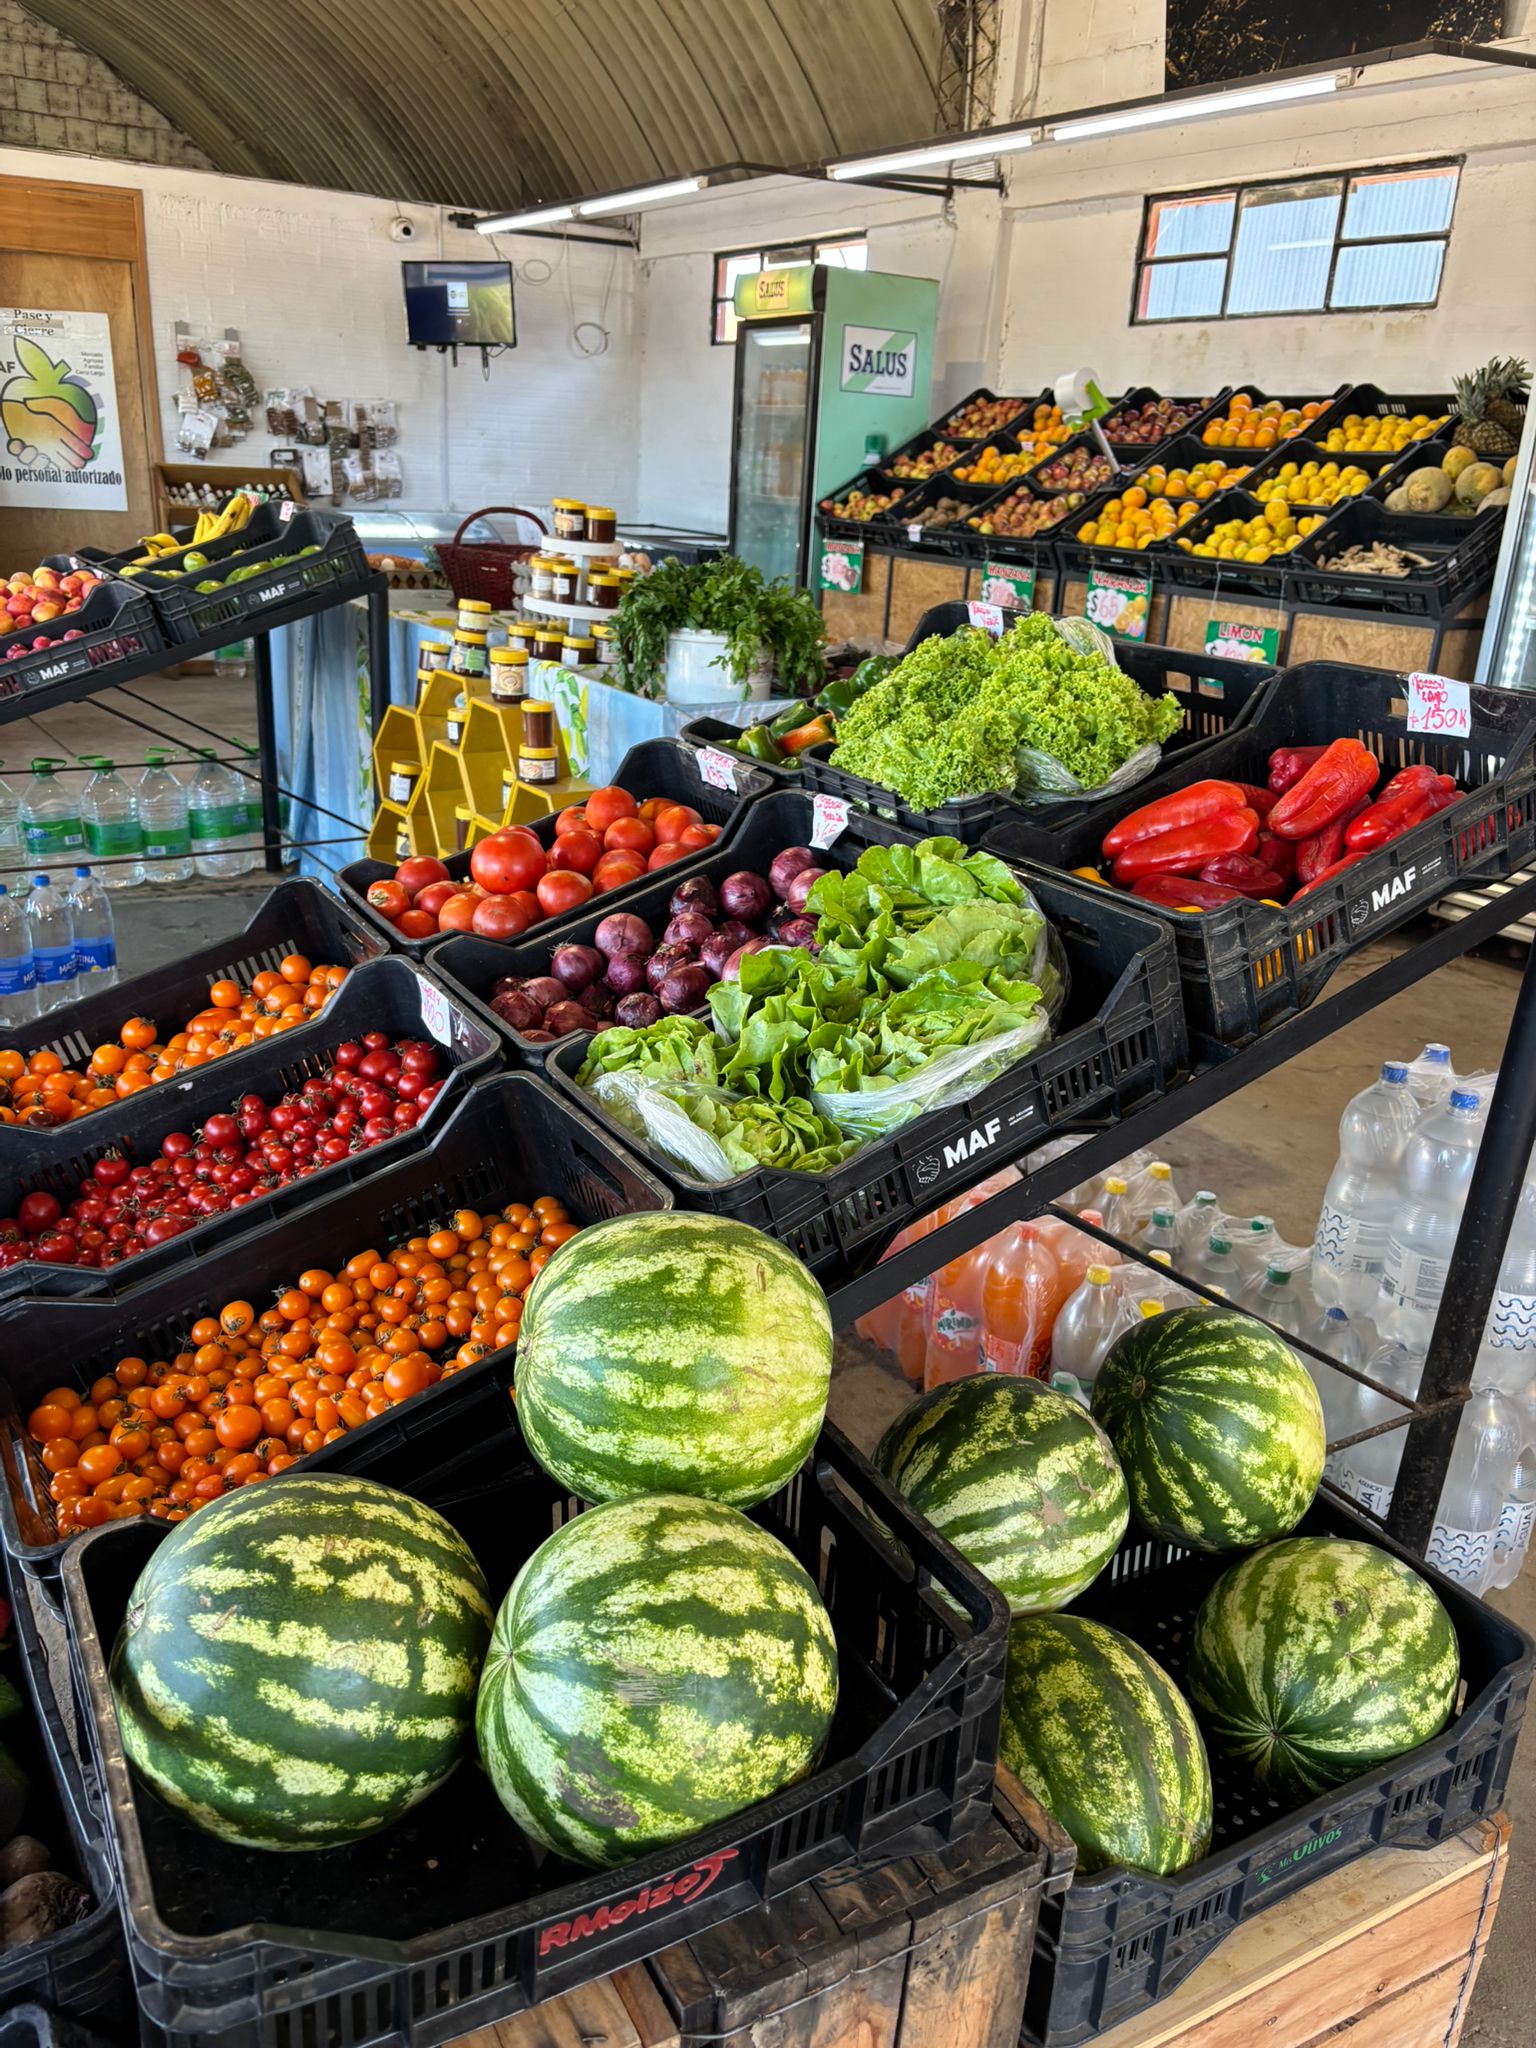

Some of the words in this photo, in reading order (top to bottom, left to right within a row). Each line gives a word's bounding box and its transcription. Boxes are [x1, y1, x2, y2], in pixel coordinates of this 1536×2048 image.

[759, 280, 785, 299] SALUS
[14, 309, 42, 320] Pase
[850, 344, 908, 378] SALUS
[15, 467, 61, 483] personal
[65, 469, 122, 485] autorizado
[259, 583, 286, 602] MAF
[39, 661, 69, 681] MAF
[1371, 866, 1417, 912] MAF
[942, 1117, 1001, 1169] MAF
